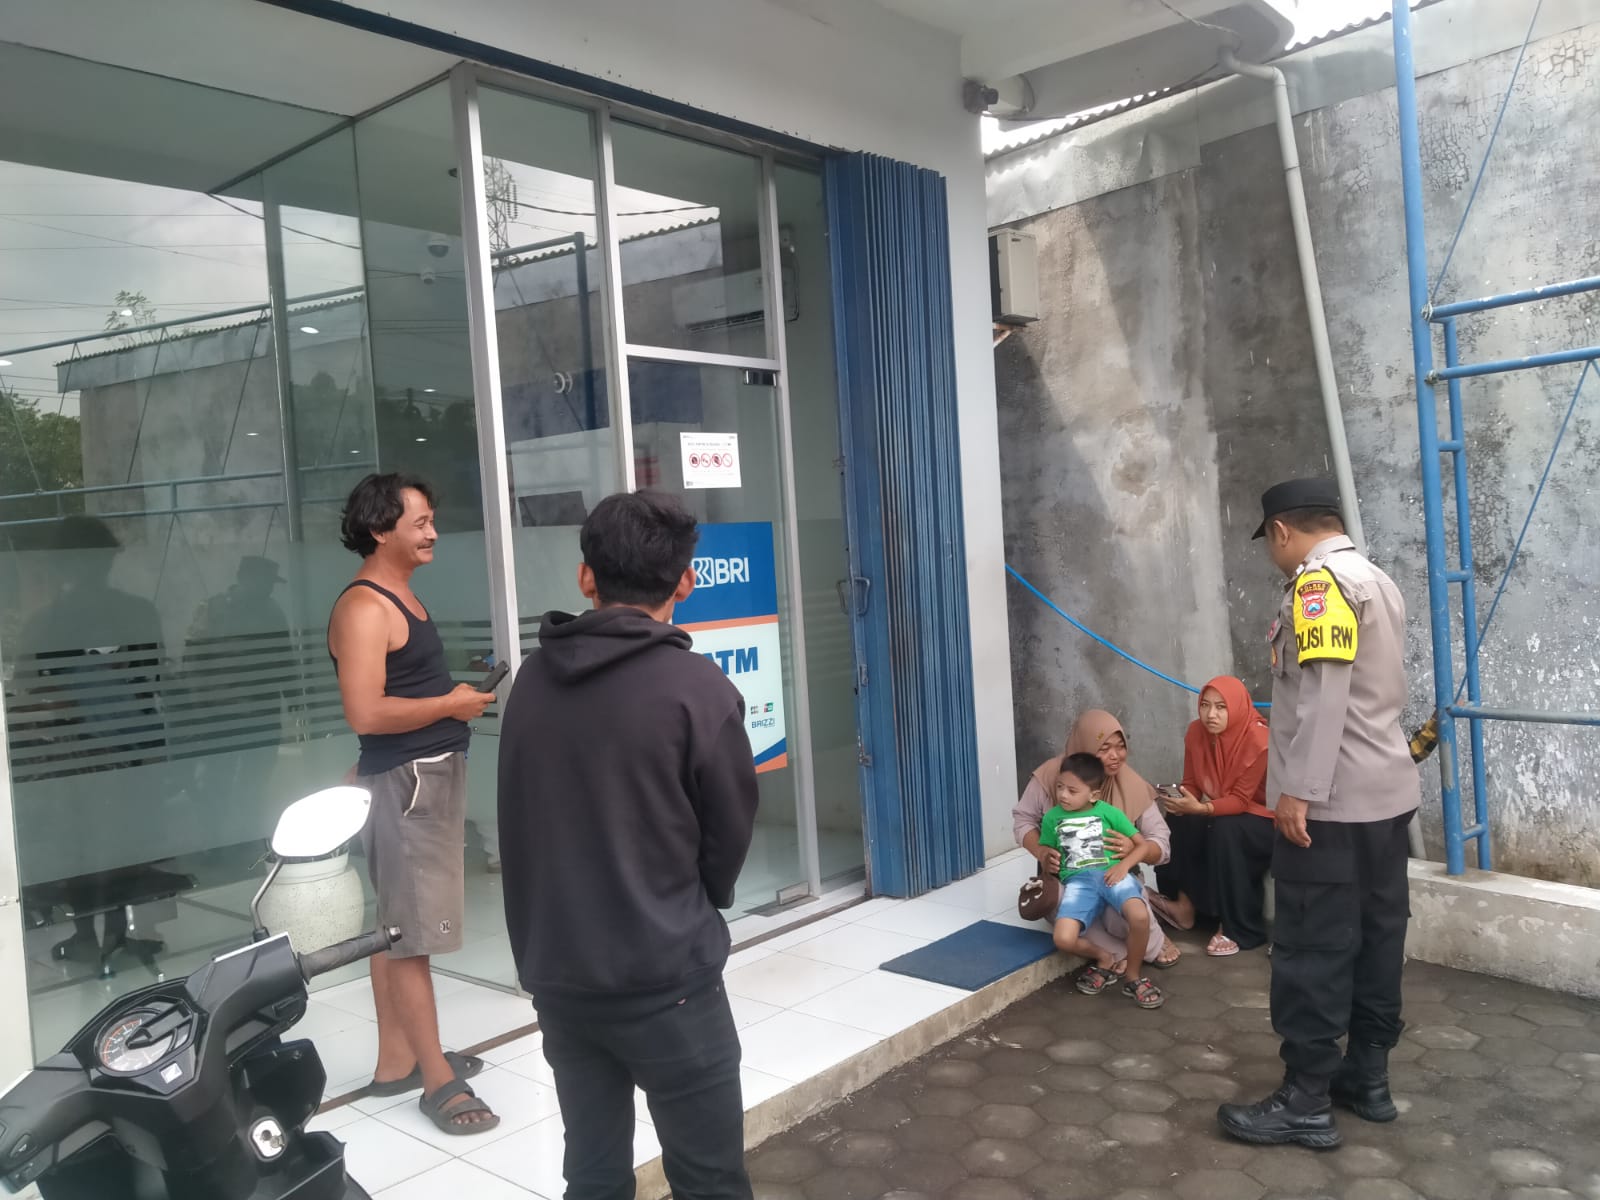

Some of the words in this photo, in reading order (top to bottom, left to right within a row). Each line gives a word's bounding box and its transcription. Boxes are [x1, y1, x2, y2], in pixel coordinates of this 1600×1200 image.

[715, 557, 750, 584] BRI
[1295, 625, 1324, 652] OLISI
[1331, 625, 1353, 650] RW
[703, 646, 759, 675] TM
